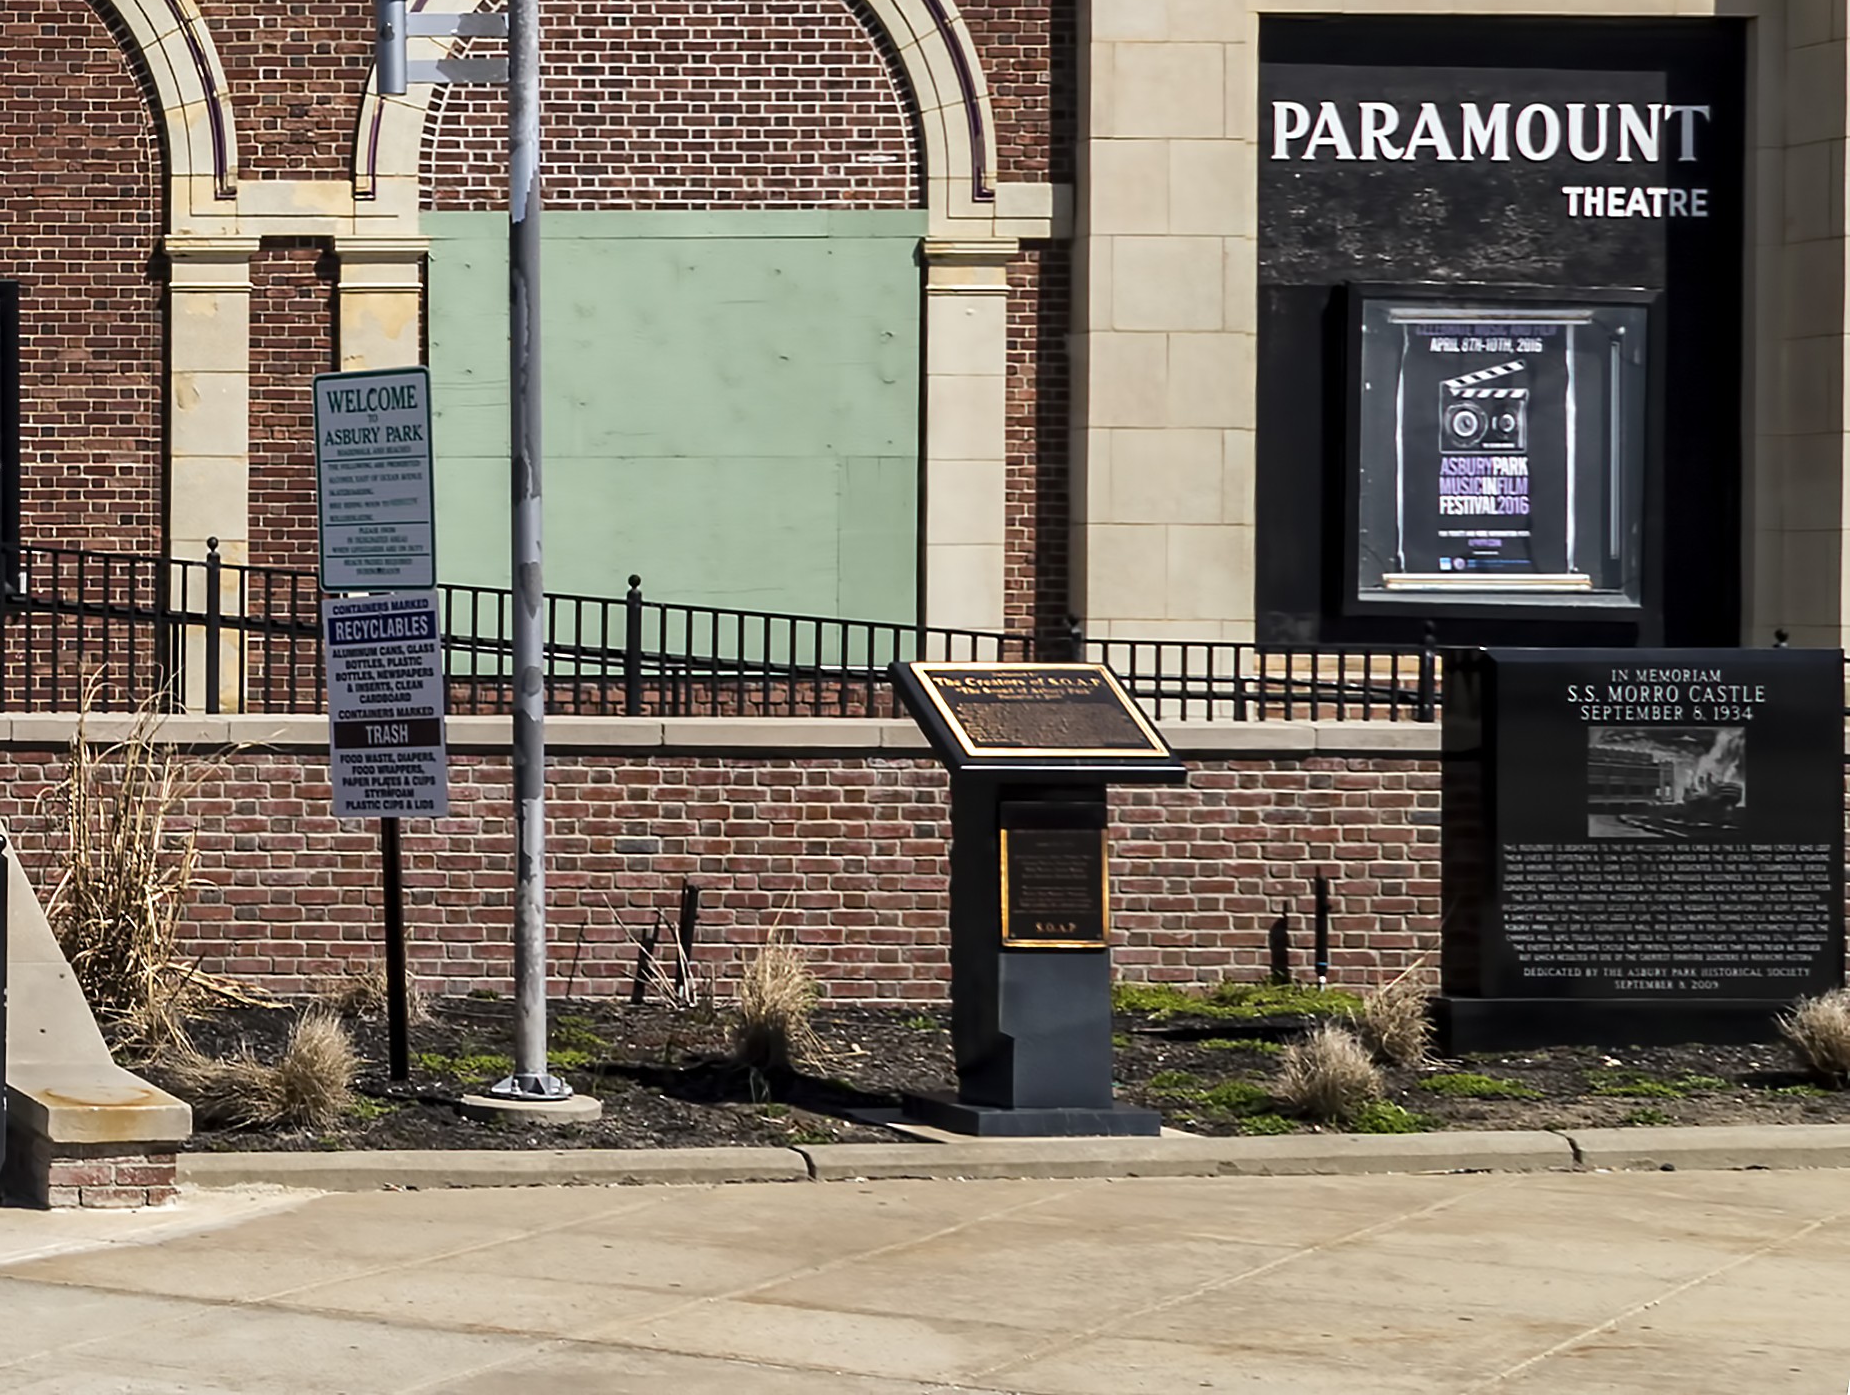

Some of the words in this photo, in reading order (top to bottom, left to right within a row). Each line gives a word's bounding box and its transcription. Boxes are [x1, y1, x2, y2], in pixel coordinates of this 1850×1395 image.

[1270, 101, 1711, 162] PARAMOUNT
[1561, 185, 1709, 218] THEATRE
[1430, 337, 1460, 352] APRIL
[327, 385, 418, 413] WELCOME
[367, 413, 378, 423] TO
[325, 426, 380, 446] ASBURY
[386, 424, 423, 443] PARK
[332, 601, 389, 615] CONTAINERS
[391, 598, 429, 611] MARKED
[335, 615, 429, 641] RECYCLABLES
[332, 648, 378, 658] ALUMINUM
[406, 643, 435, 653] GLASS
[387, 656, 423, 668] PLASTIC
[377, 668, 434, 680] NEWSPAPERS
[1611, 669, 1629, 683] IN
[1635, 669, 1722, 683] MEMORIAM
[395, 680, 423, 691] CLEAN
[359, 692, 412, 704] CARDBOARD
[1567, 685, 1600, 703] S.S.
[1607, 685, 1679, 703] MORRO
[1688, 685, 1766, 703] CASTLE
[338, 708, 394, 720] CONTAINERS
[396, 706, 434, 717] MARKED
[1580, 705, 1684, 721] SEPTEMBER
[1713, 705, 1754, 721] 1934
[365, 723, 409, 744] TRASH
[340, 754, 363, 764] FOOD
[352, 765, 375, 775] FOOD
[342, 777, 370, 787] PAPER
[371, 776, 401, 787] PLATES
[412, 775, 435, 786] CUPS
[346, 800, 381, 810] PLASTIC
[383, 800, 404, 810] CUPS
[415, 800, 434, 809] LIDS
[1523, 967, 1582, 977] DEDICATED
[1585, 967, 1598, 977] BY
[1603, 967, 1623, 977] THE
[1627, 967, 1667, 977] ASBURY
[1671, 967, 1697, 977] PARK
[1701, 967, 1763, 977] HISTORICAL
[1767, 967, 1810, 977] SOCIETY
[1615, 980, 1673, 989] SEPTEMBER
